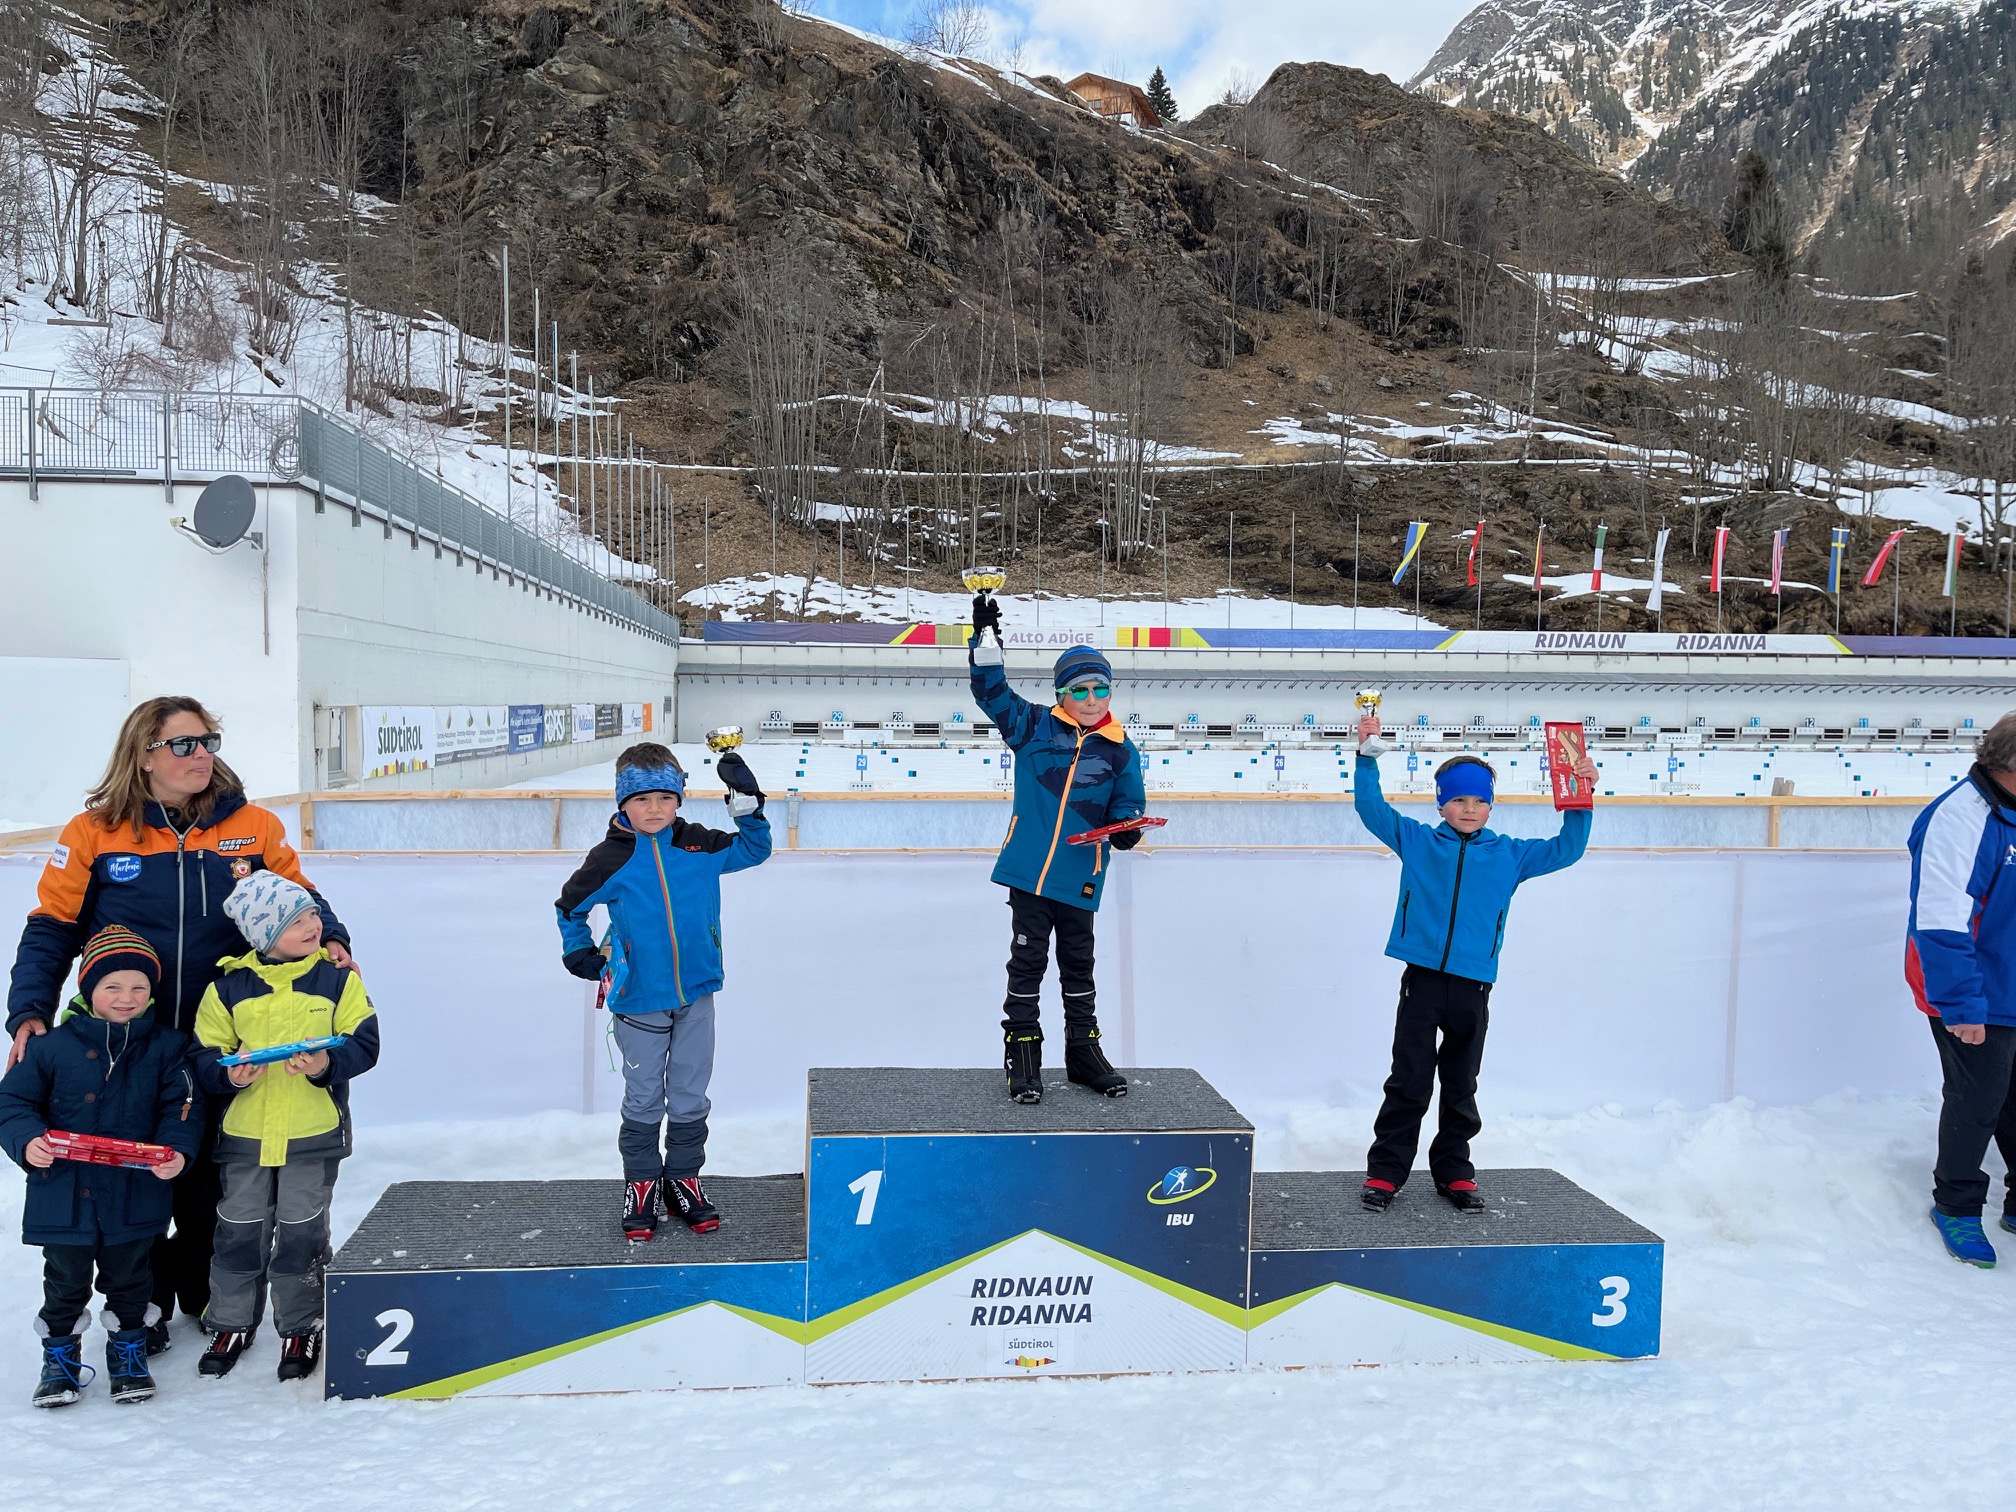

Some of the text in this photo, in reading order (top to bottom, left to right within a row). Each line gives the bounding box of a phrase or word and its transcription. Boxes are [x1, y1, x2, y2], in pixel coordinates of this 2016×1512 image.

[1535, 633, 1767, 650] RIDNAUN RIDANNA
[771, 711, 781, 721] 30
[832, 711, 842, 721] 29
[893, 712, 903, 722] 28
[953, 713, 963, 722] 27
[1130, 714, 1139, 723] 24
[1188, 714, 1198, 724] 23
[1246, 715, 1256, 724] 22
[1304, 715, 1314, 724] 21
[1418, 716, 1428, 725] 19
[1474, 716, 1484, 726] 18
[1531, 717, 1540, 726] 17
[1586, 717, 1595, 726] 16
[1641, 717, 1650, 726] 15
[1696, 717, 1705, 726] 14
[1751, 717, 1760, 727] 13
[1805, 718, 1814, 727] 12
[1859, 718, 1868, 727] 11
[1913, 719, 1921, 728] 10
[147, 740, 167, 750] UDY
[857, 757, 866, 767] 29
[1002, 756, 1010, 765] 28
[1140, 758, 1148, 766] 27
[1276, 758, 1284, 767] 26
[1408, 758, 1417, 767] 25
[1541, 758, 1549, 767] 24
[1669, 760, 1677, 768] 23
[110, 861, 140, 876] Marlene
[847, 1170, 883, 1226] 1
[1166, 1213, 1194, 1226] IBU
[970, 1275, 1093, 1299] RIDNAUN
[1592, 1275, 1630, 1327] 3
[970, 1303, 1092, 1327] RIDANNA
[365, 1308, 414, 1366] 2
[305, 1333, 316, 1359] MAD
